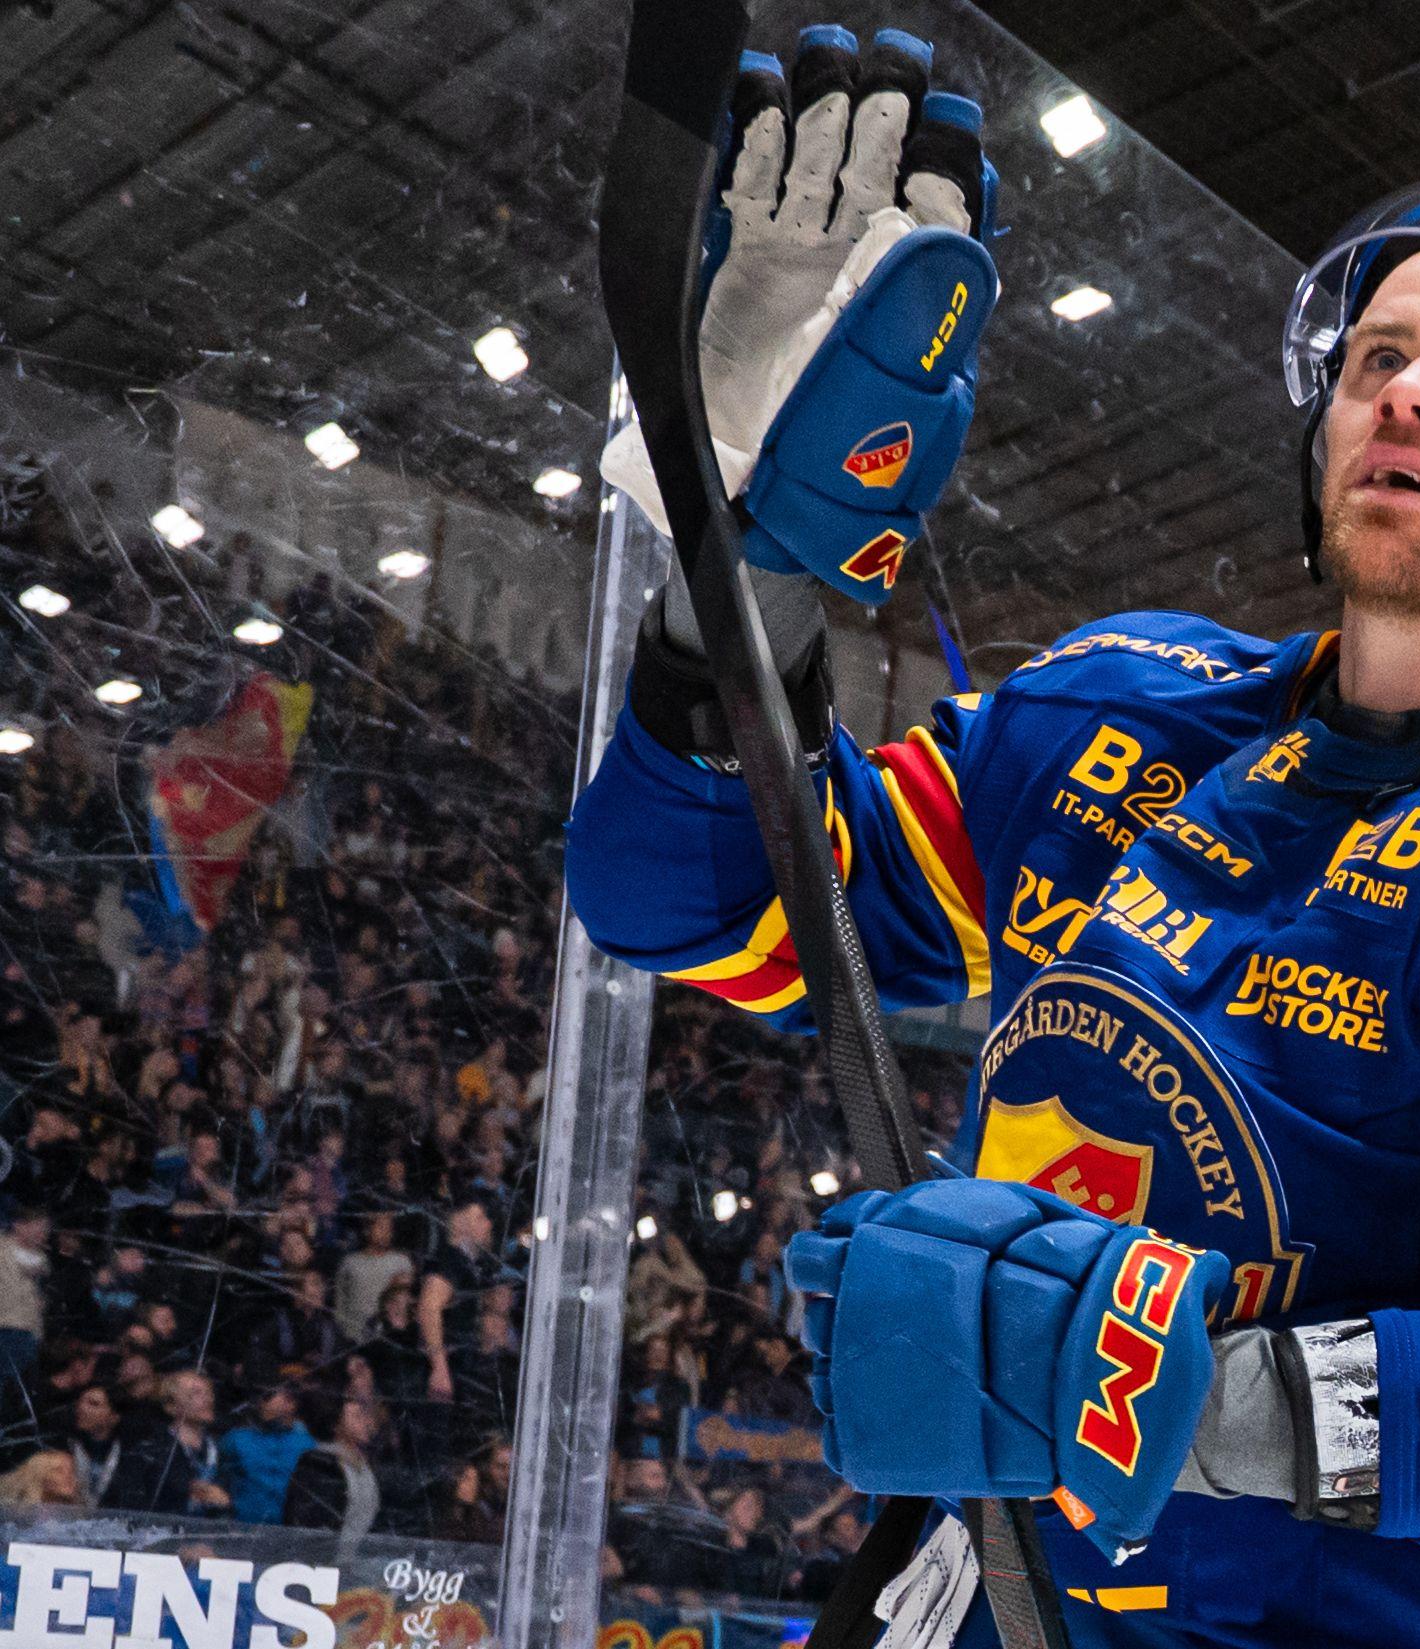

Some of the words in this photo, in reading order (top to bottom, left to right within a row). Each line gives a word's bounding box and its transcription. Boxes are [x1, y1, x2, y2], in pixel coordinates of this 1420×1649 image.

[920, 281, 968, 372] CCM
[1155, 813, 1254, 878] CCM
[1226, 953, 1389, 1018] HOCKEY
[1119, 1034, 1245, 1220] HOCKEY
[1076, 1228, 1207, 1477] CM
[384, 1558, 467, 1604] Bygg
